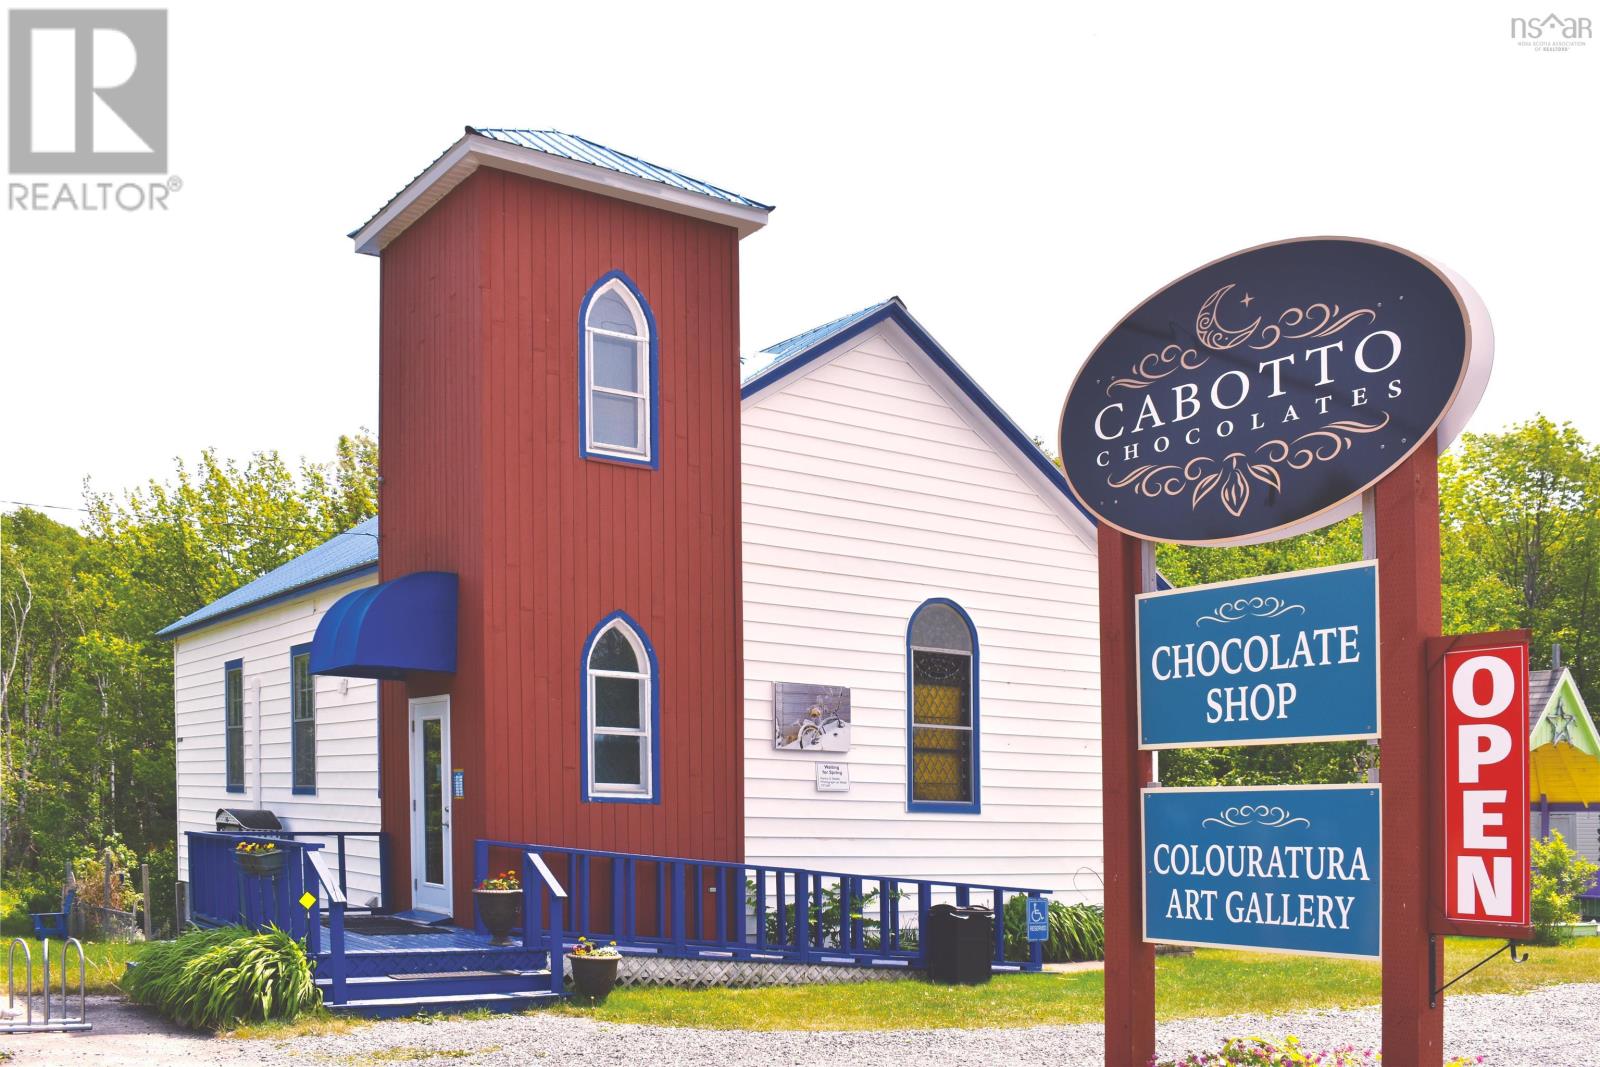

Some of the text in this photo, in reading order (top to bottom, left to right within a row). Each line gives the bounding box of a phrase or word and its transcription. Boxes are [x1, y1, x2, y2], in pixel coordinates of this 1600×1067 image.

[1094, 330, 1402, 441] CABOTTO
[1096, 379, 1402, 467] CHOCOLATES
[1151, 625, 1361, 682] CHOCOLATE
[1206, 682, 1298, 724] SHOP
[1452, 655, 1515, 917] OPEN
[1153, 843, 1371, 881] COLOURATURA
[1165, 888, 1356, 930] ART GALLERY
